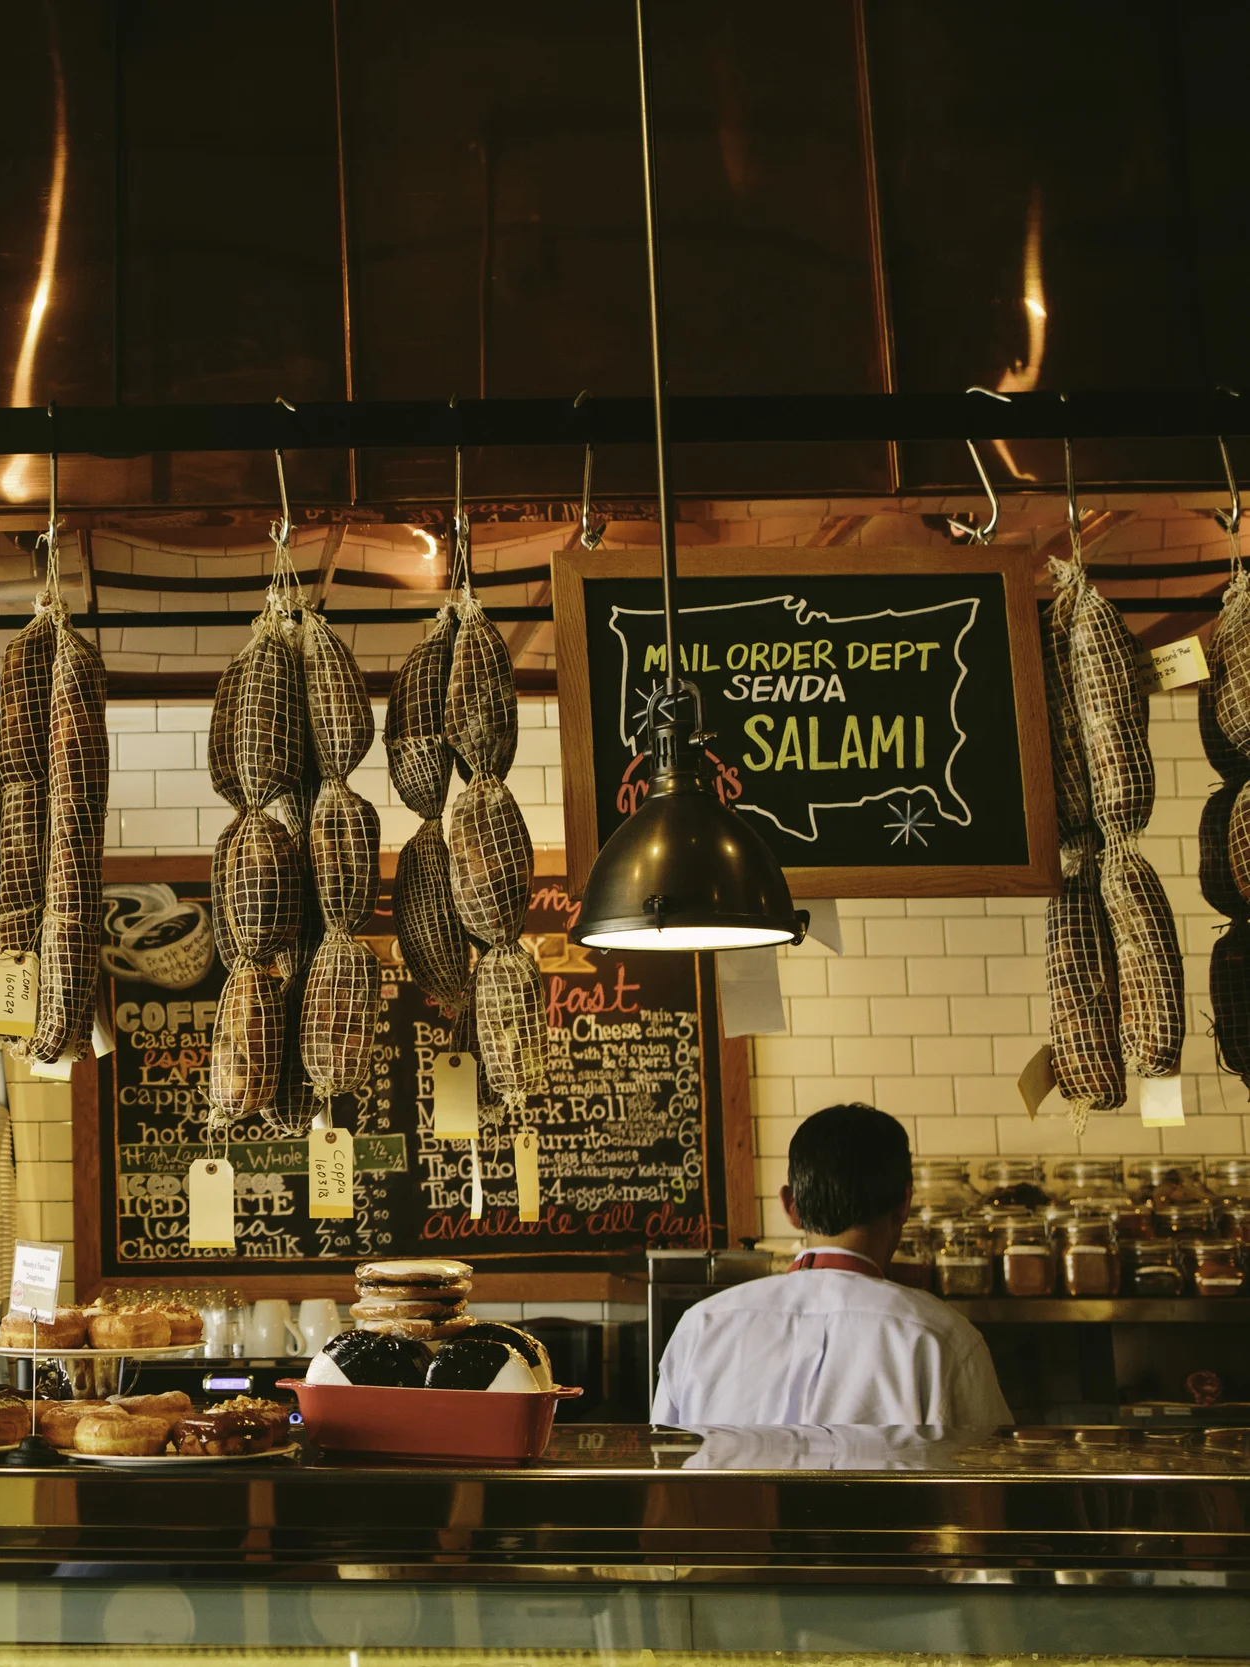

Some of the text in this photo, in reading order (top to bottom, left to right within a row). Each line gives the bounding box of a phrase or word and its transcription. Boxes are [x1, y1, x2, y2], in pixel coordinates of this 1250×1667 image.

[726, 640, 836, 672] ORDER
[846, 641, 940, 672] DEPT
[724, 674, 846, 703] SENDA
[742, 714, 925, 771] SALAMI
[3, 973, 17, 1014] 160429
[116, 1001, 218, 1033] COFF
[573, 1014, 642, 1042] Cheese
[131, 1029, 211, 1050] Café au
[602, 1041, 628, 1057] red
[139, 1066, 211, 1087] LAT
[568, 1095, 627, 1122] Roll
[137, 1122, 189, 1145] hot
[199, 1123, 283, 1145] cocoa
[315, 1159, 329, 1199] 160318
[331, 1150, 346, 1194] Coppa
[418, 1154, 457, 1181] The
[119, 1195, 188, 1218] ICED
[421, 1181, 460, 1209] The
[622, 1179, 669, 1202] meat
[586, 1202, 642, 1235] all
[242, 1234, 304, 1259] milk
